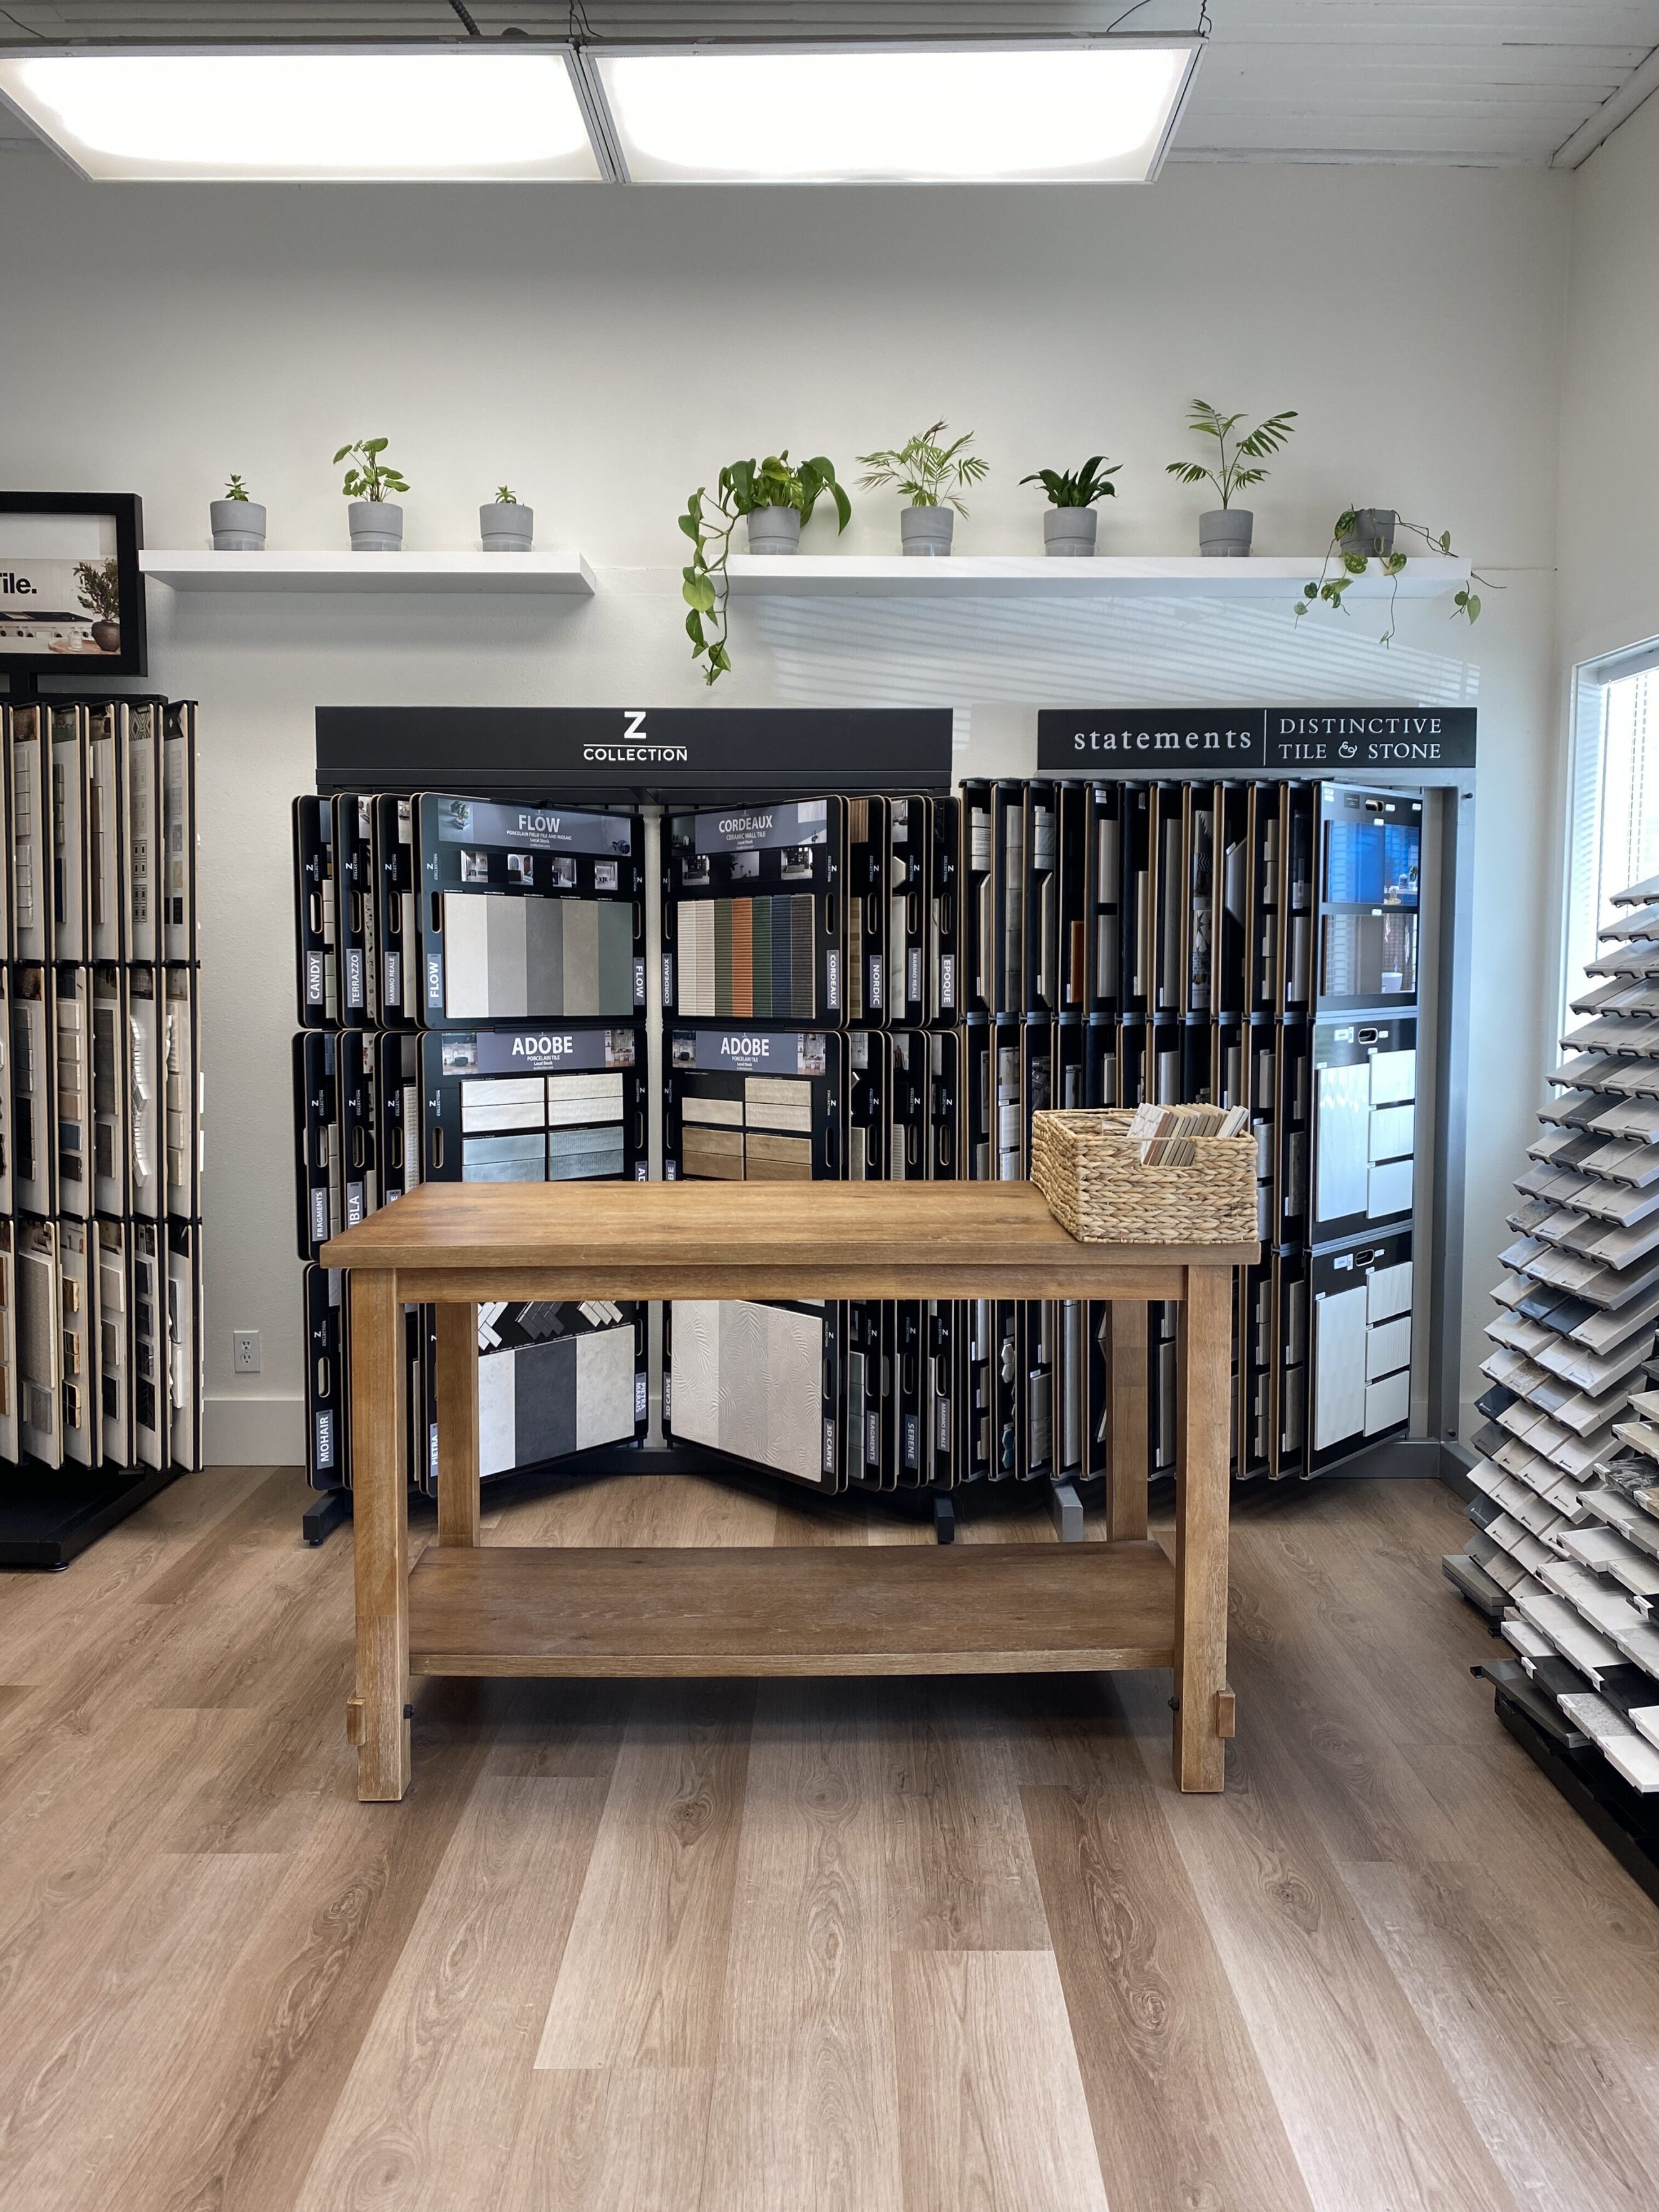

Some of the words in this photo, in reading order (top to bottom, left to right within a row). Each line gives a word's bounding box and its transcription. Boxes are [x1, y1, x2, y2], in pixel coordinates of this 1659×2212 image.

[624, 711, 646, 739] Z
[1280, 718, 1441, 734] DISTINCTIVE
[1074, 730, 1251, 749] statements
[583, 748, 687, 761] COLLECTION
[1278, 743, 1327, 759] TILE
[1338, 741, 1357, 758] &
[1369, 743, 1441, 759] STONE
[519, 815, 560, 833] FLOW
[719, 815, 773, 833] CORDEAUX
[726, 833, 744, 841] CERAMIC
[311, 957, 321, 1000] CANDY
[430, 962, 439, 997] FLOW
[511, 1036, 573, 1056] ADOBE
[721, 1037, 769, 1056] ADOBE
[350, 1195, 360, 1226] IBLA
[665, 1405, 670, 1417] 3D
[321, 1416, 329, 1463] MOHAIR
[826, 1424, 832, 1437] 3D
